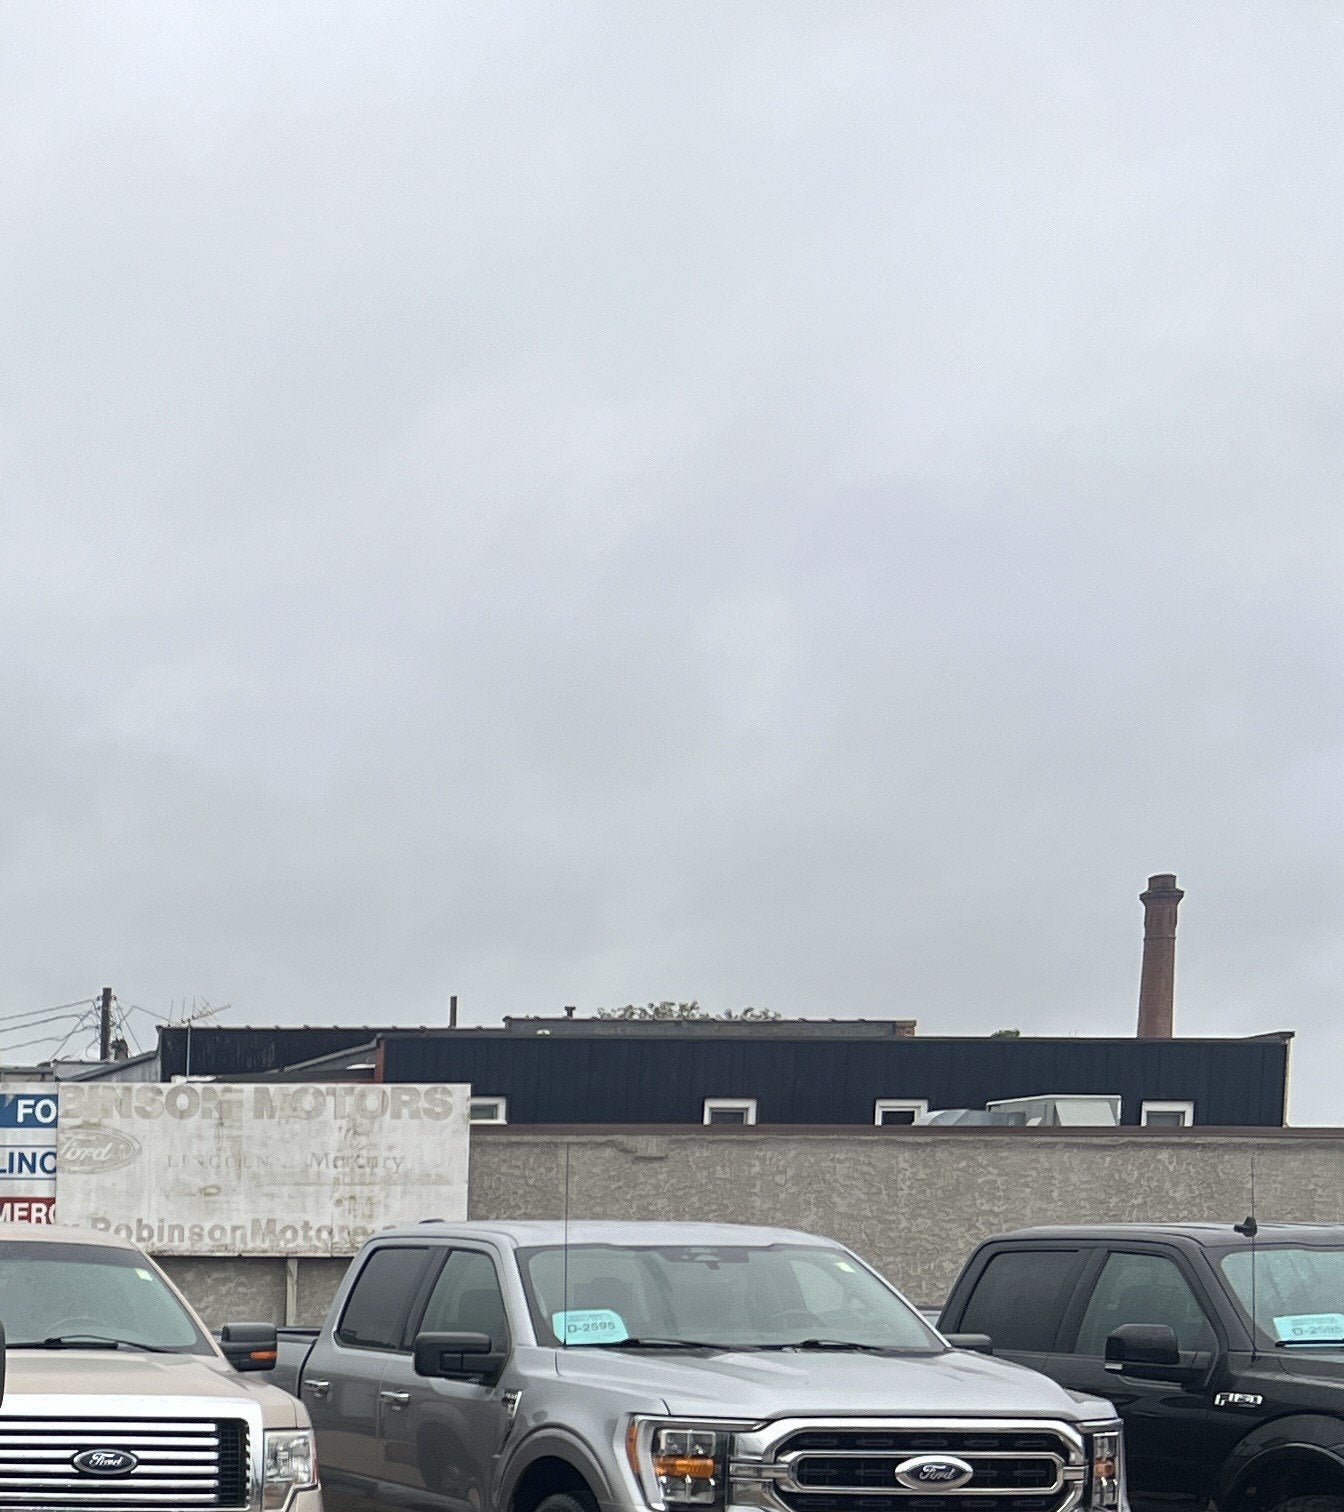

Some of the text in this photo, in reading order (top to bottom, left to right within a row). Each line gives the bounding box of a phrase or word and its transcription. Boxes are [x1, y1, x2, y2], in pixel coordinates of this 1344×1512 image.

[253, 1085, 454, 1121] MOTORS
[89, 1452, 124, 1467] Ford
[919, 1464, 956, 1480] Ford
